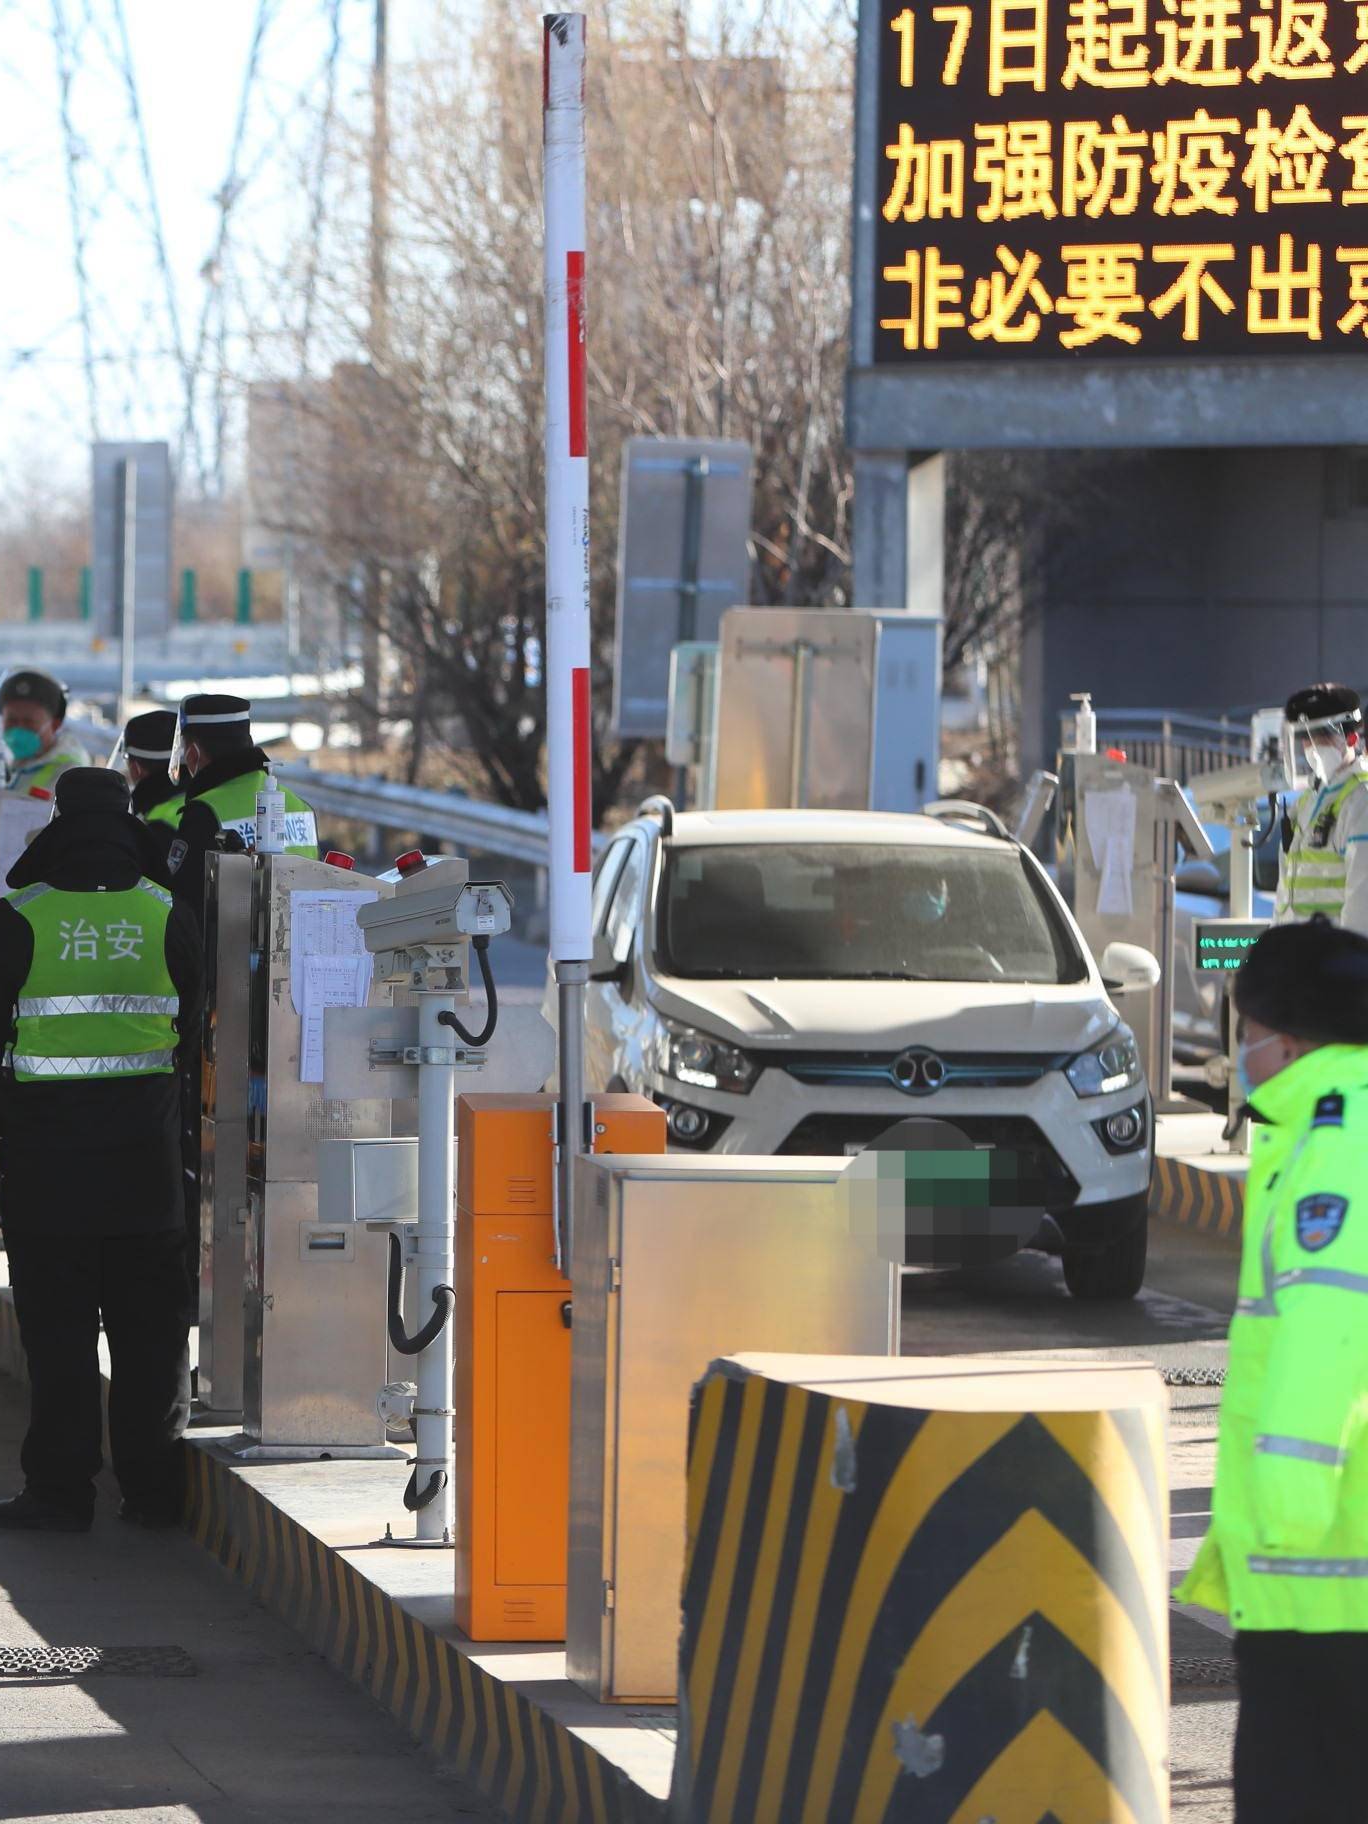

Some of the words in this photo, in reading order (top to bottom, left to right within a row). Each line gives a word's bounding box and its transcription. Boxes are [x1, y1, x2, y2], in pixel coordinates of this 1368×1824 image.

[890, 0, 1368, 96] 17日起进返
[59, 918, 144, 961] 治安
